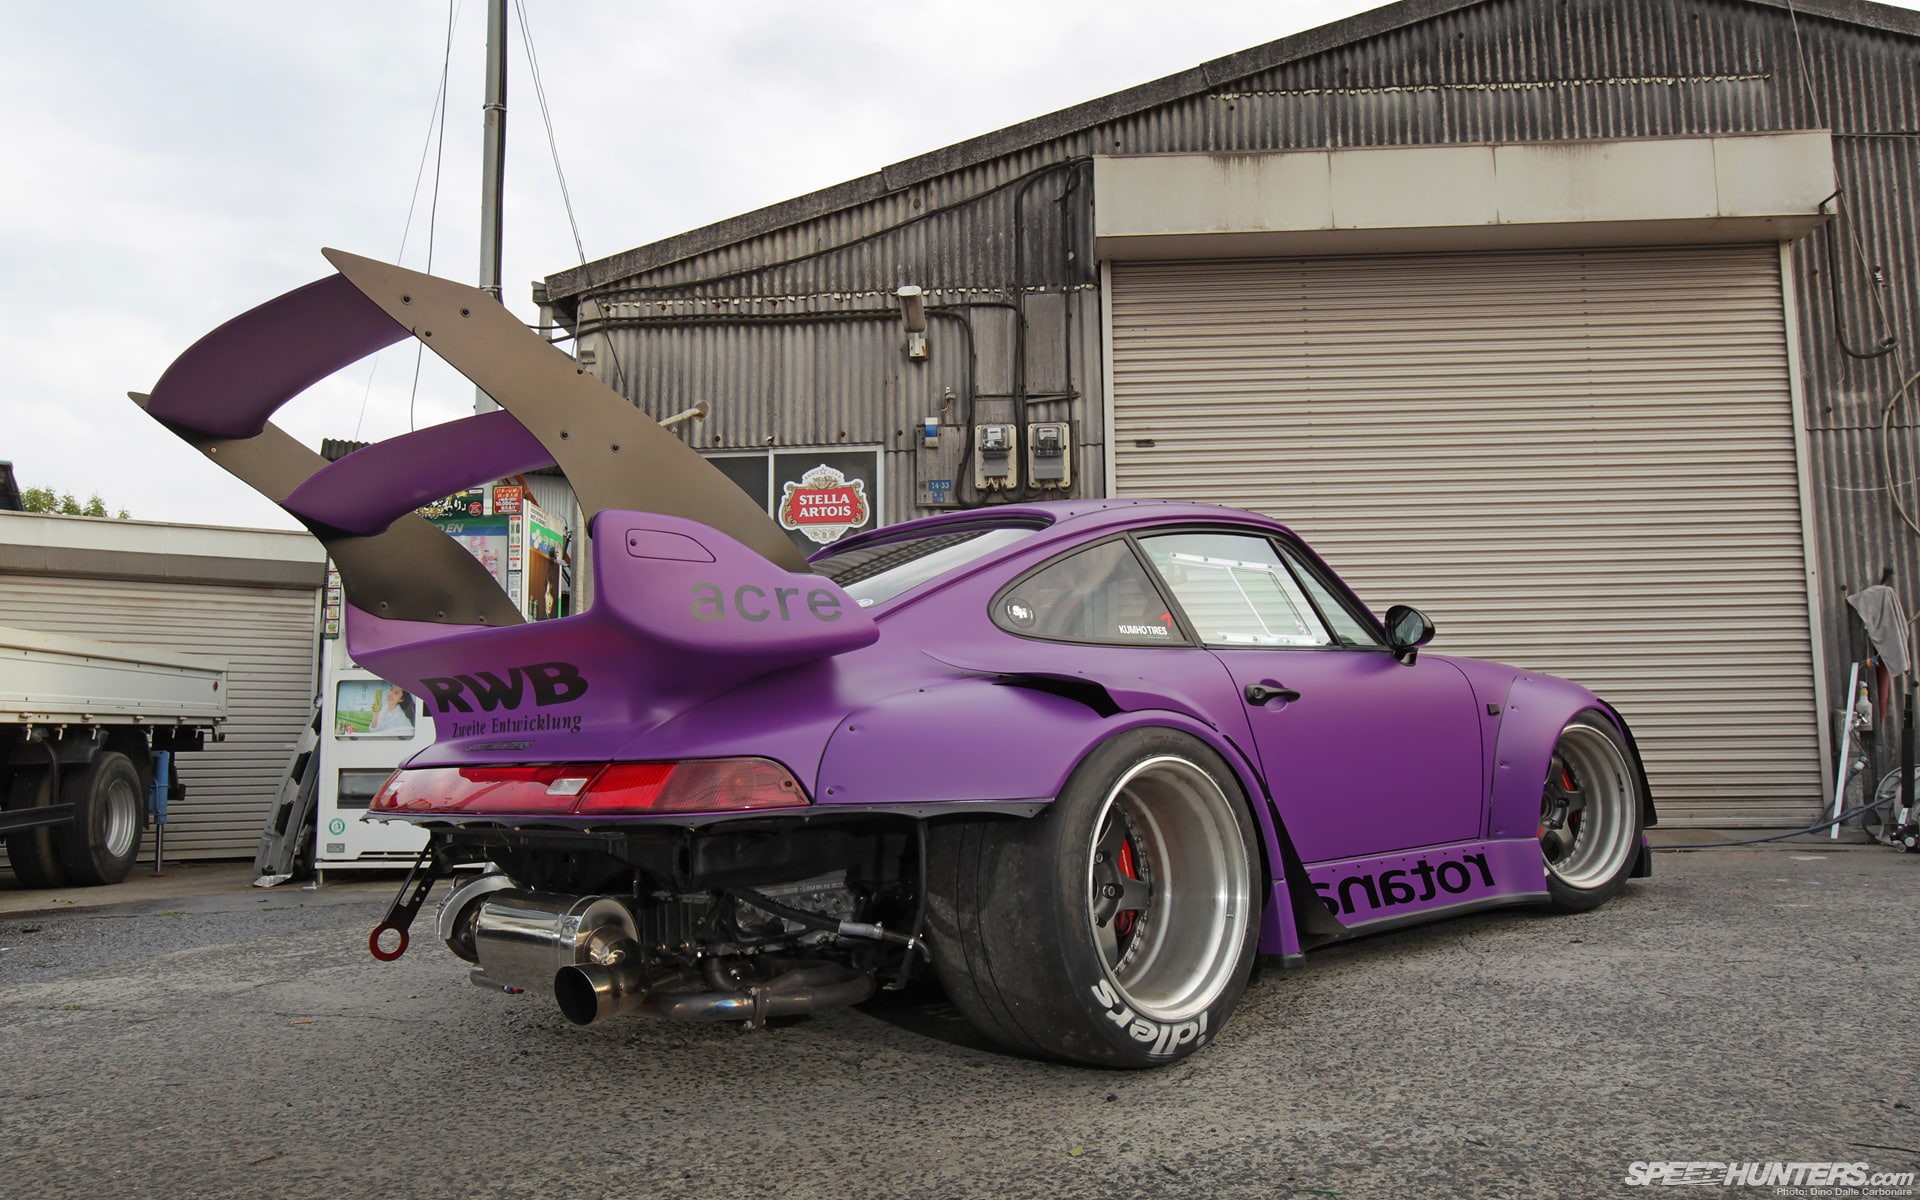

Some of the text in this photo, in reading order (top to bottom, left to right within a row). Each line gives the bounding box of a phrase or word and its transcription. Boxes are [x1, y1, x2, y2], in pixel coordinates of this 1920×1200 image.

[799, 494, 850, 505] STELLA
[799, 506, 851, 517] ARTOIS
[688, 582, 843, 623] acre
[1118, 625, 1168, 636] KUMHO TIRES
[420, 661, 589, 713] RWB
[452, 713, 582, 738] Zweite Entwicklung
[1090, 979, 1208, 1054] idlers
